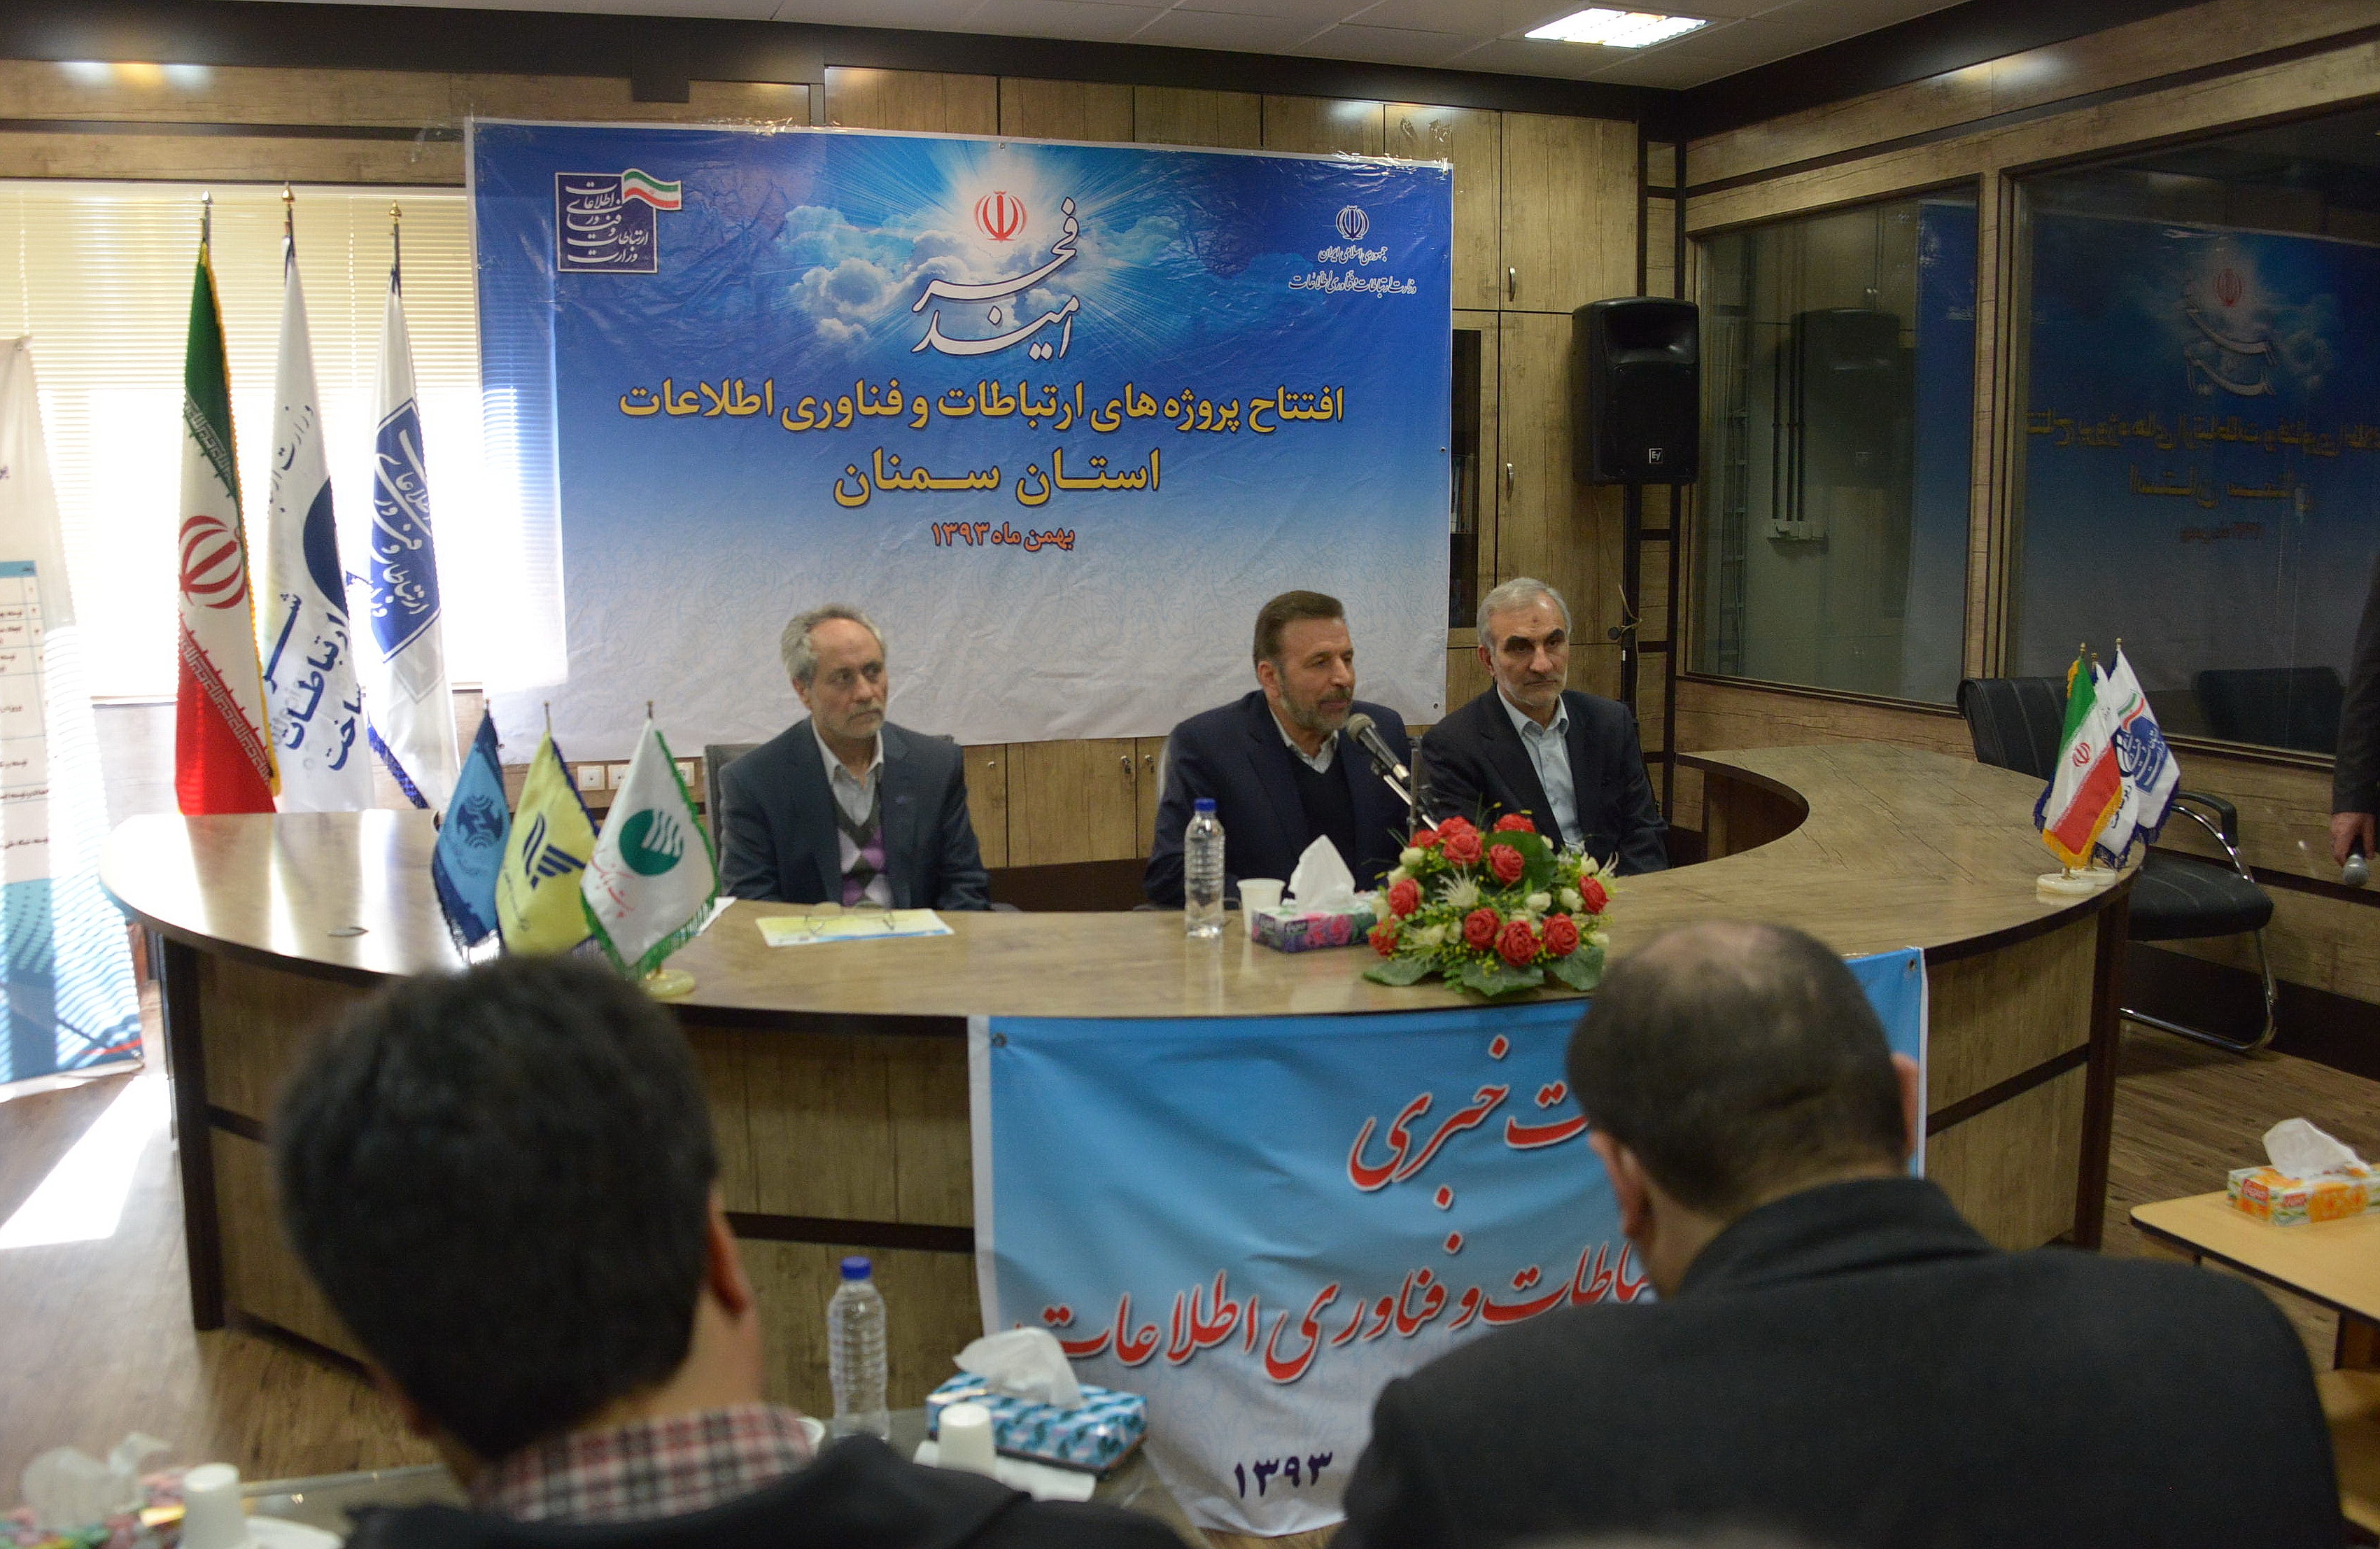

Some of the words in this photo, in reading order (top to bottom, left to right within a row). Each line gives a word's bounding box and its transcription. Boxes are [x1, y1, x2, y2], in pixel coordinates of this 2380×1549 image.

[911, 196, 1080, 325] فجر
[911, 295, 1080, 360] امید
[619, 378, 774, 417] اطلاعات
[780, 378, 905, 431] فناوری
[909, 394, 930, 429] و
[937, 379, 1084, 430] ارتباطات
[1090, 382, 1158, 432] های
[1163, 387, 1241, 432] پروژه
[1248, 384, 1344, 433] افتتاح
[833, 447, 1001, 507] سمنان
[1015, 448, 1160, 506] استان
[931, 521, 990, 547] ۱۳۹۳
[991, 522, 1021, 545] ماه
[1024, 527, 1075, 551] بهمن
[1347, 1035, 1509, 1210] خبری
[1265, 1231, 1463, 1383] فناوری
[1448, 1285, 1481, 1329] و
[1234, 1451, 1333, 1499] ۱۳۹۳
